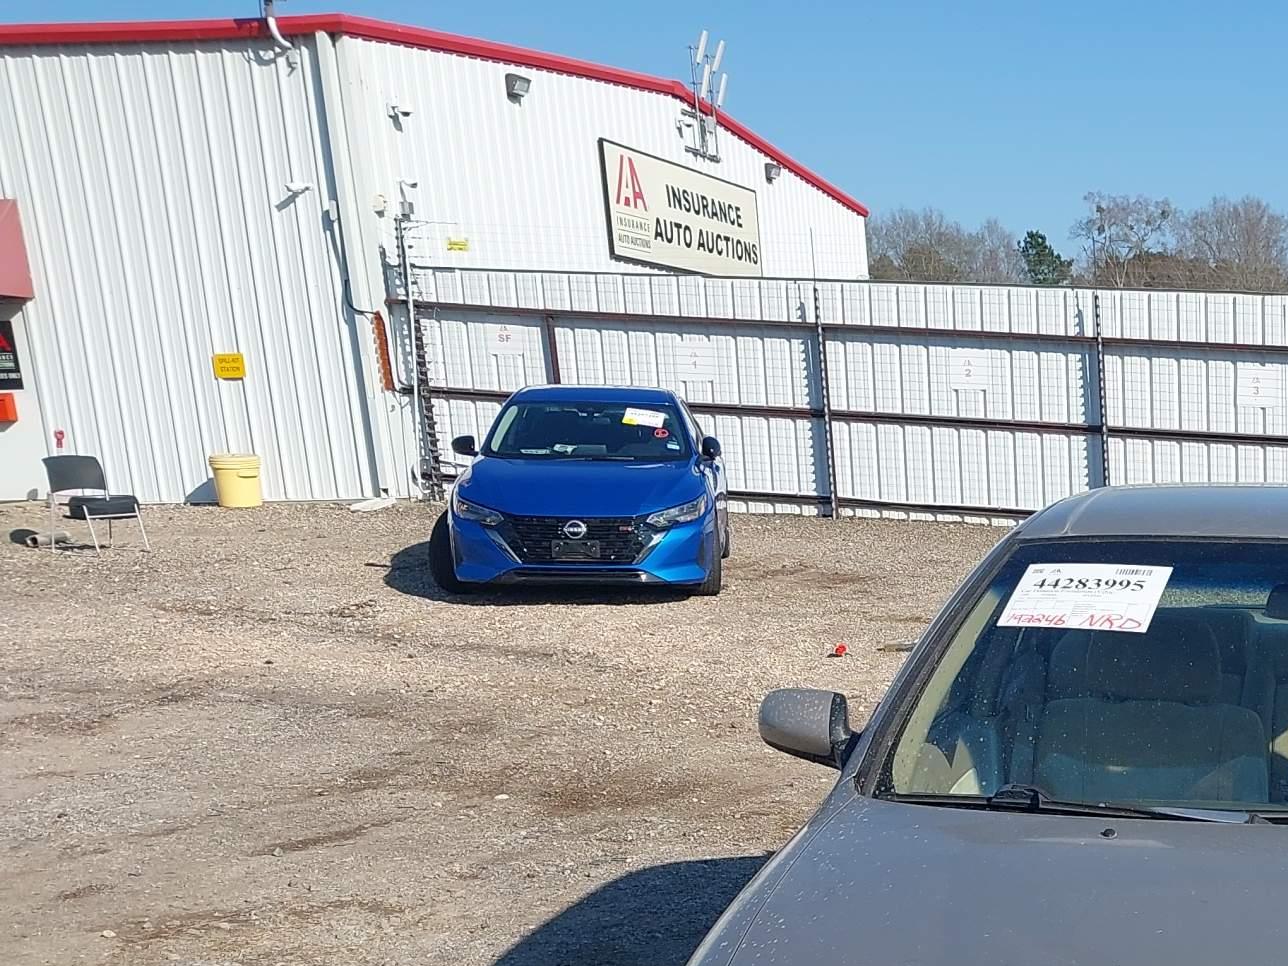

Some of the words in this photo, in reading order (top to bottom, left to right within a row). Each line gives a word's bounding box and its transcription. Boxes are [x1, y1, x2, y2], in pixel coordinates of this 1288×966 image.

[665, 183, 743, 228] INSURANCE
[616, 215, 650, 233] INSURANCE
[618, 233, 630, 245] AUTO
[630, 235, 651, 249] AUCTIONS
[654, 216, 693, 249] AUTO
[697, 229, 759, 265] AUCTIONS
[498, 333, 512, 343] SF
[964, 368, 972, 378] 2
[1253, 386, 1260, 395] 3
[1033, 577, 1148, 592] 44283995
[1079, 613, 1142, 630] NRD
